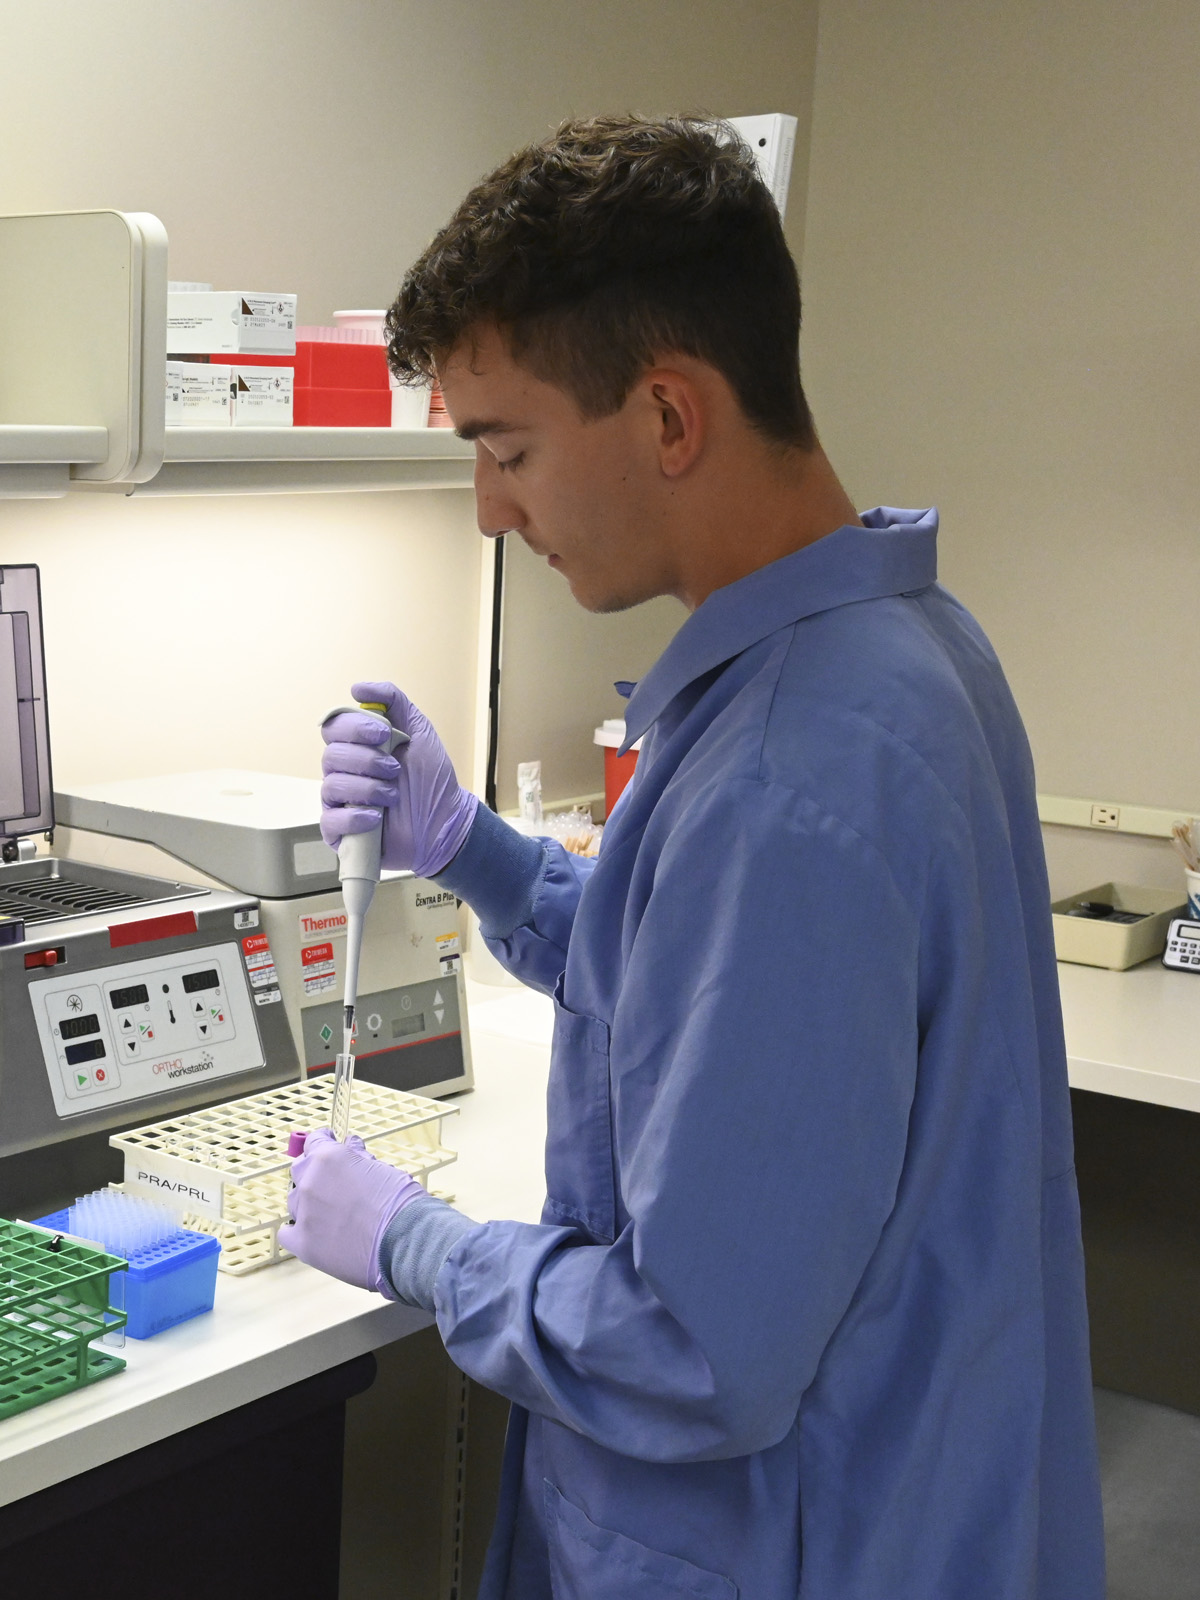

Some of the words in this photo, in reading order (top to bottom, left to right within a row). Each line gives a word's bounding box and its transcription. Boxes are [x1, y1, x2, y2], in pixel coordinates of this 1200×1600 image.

[415, 896, 436, 907] CENTRA
[437, 894, 442, 903] B
[443, 892, 455, 902] Plus
[301, 914, 347, 932] Thermo
[167, 1061, 214, 1079] workstation
[138, 1171, 211, 1203] PRA/PRL
